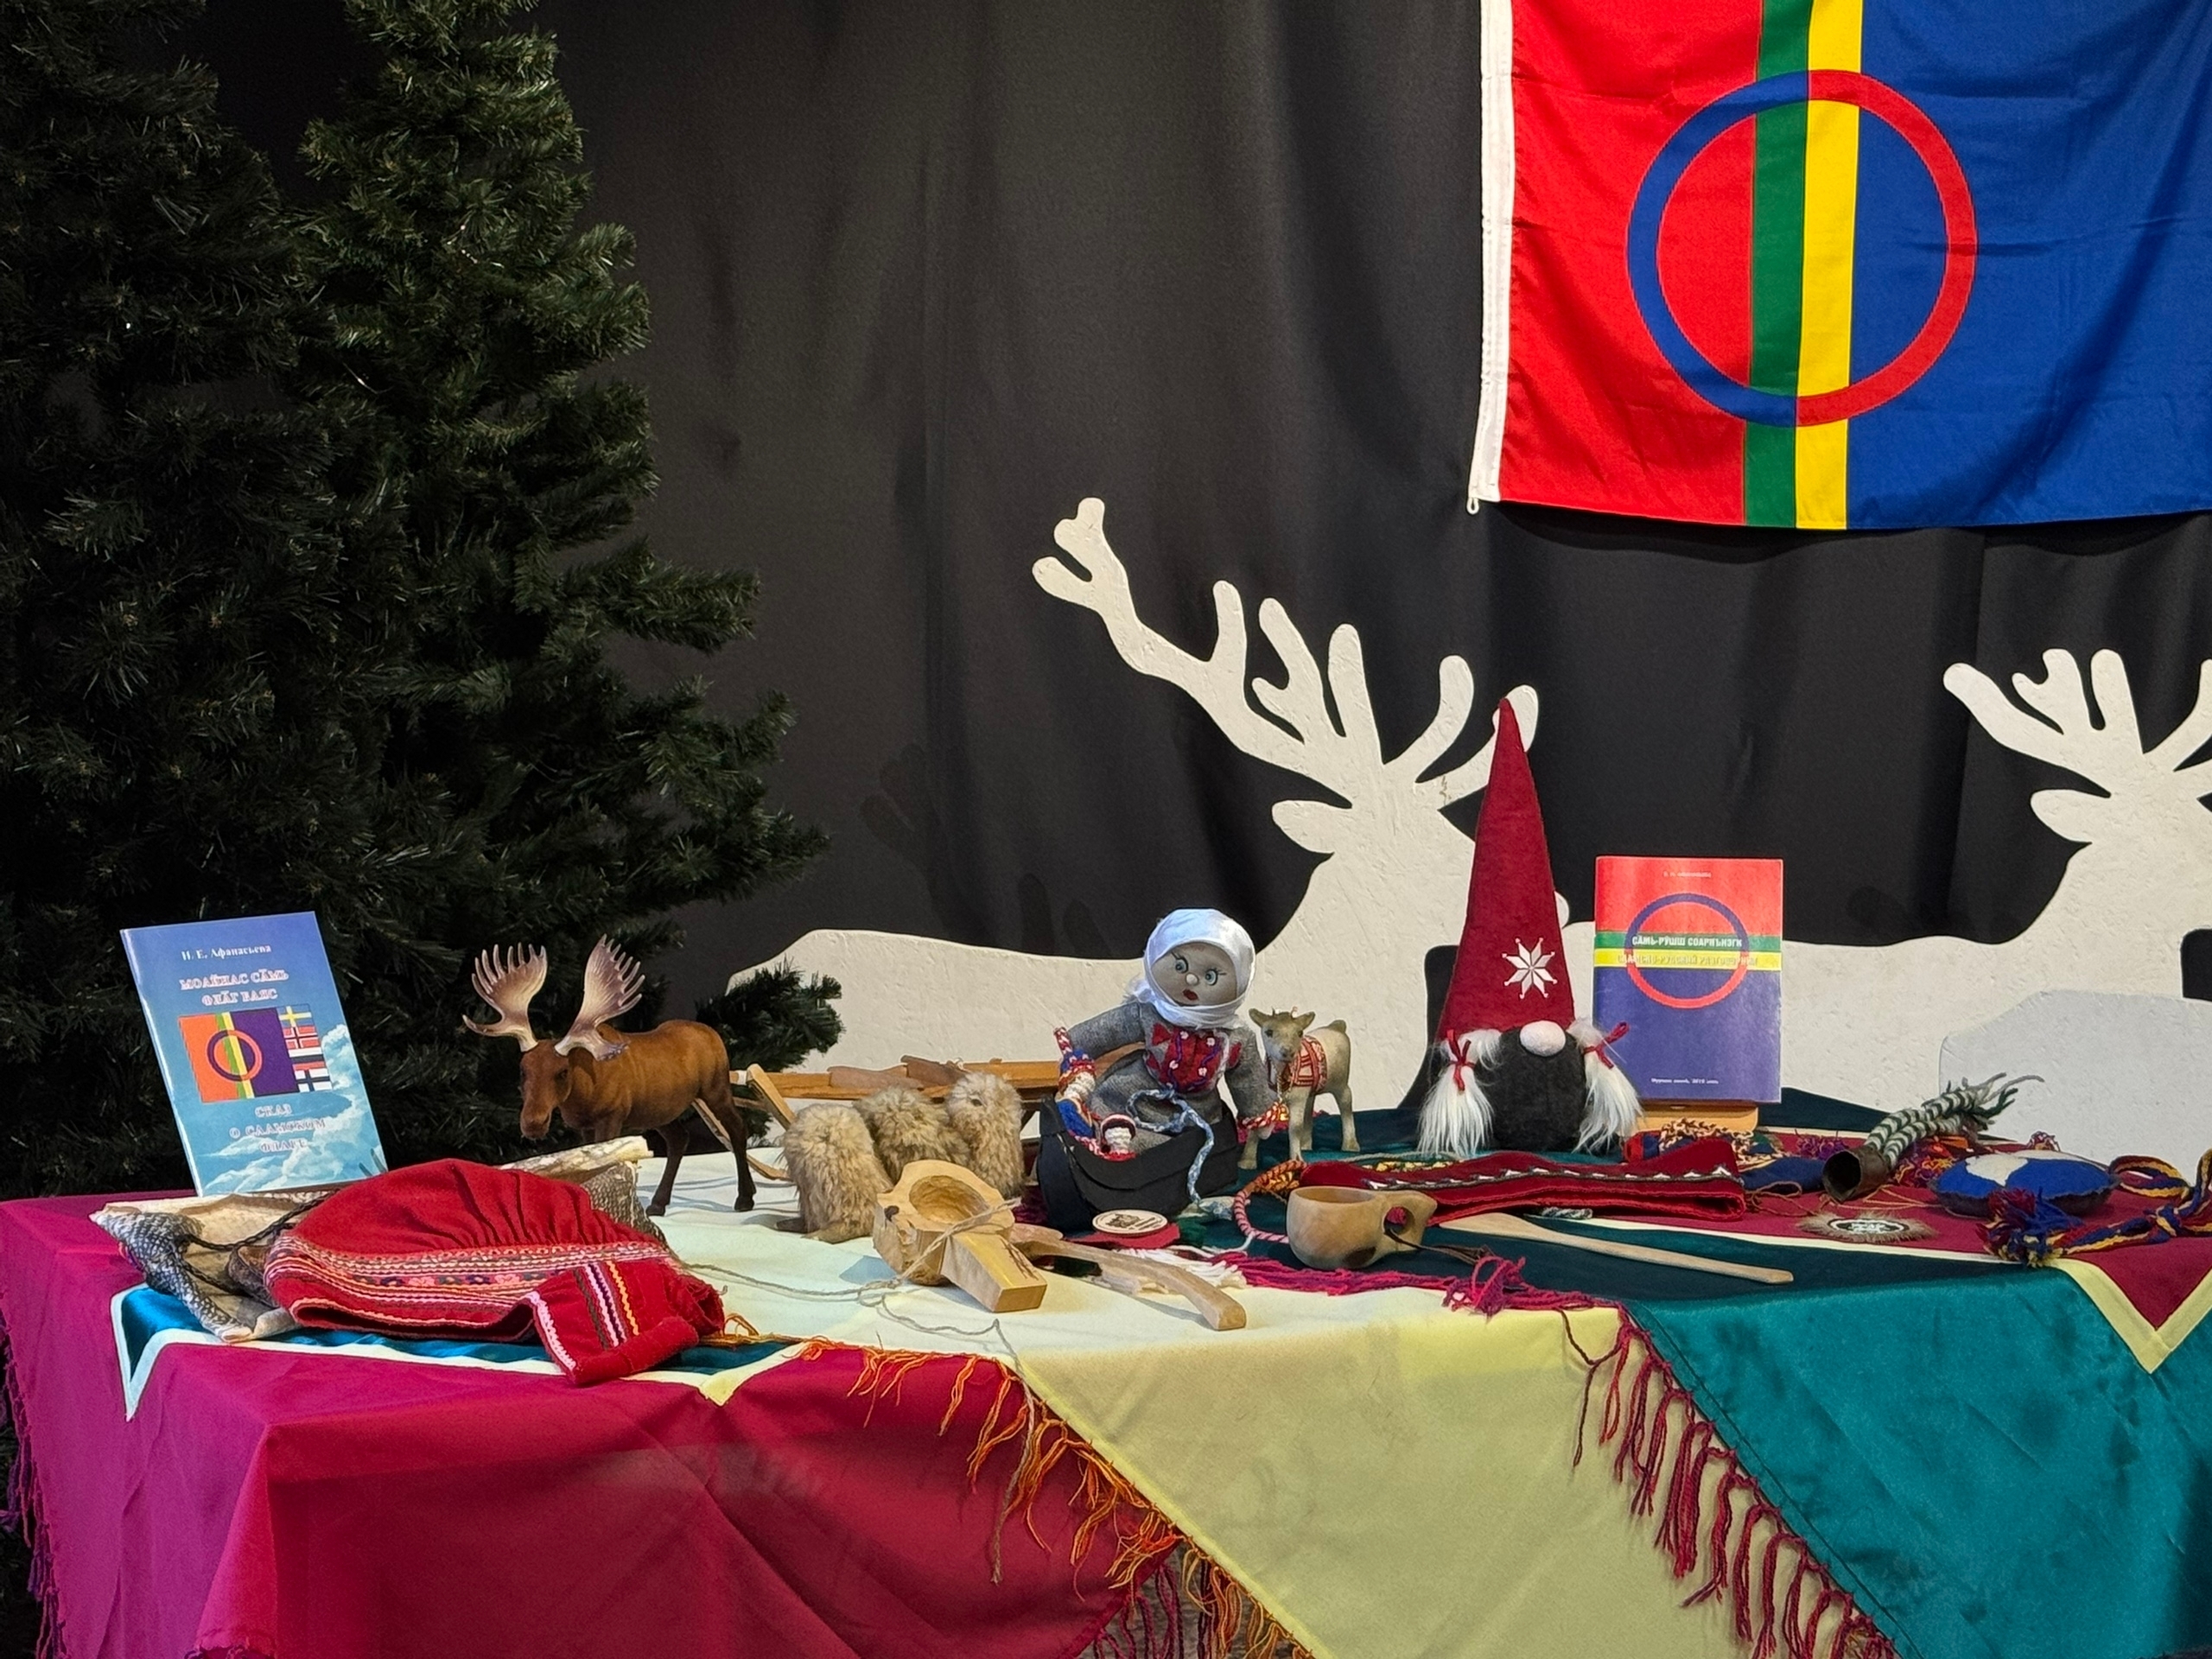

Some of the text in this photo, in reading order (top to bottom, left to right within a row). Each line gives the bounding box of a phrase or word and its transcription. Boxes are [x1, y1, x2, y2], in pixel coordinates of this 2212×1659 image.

[210, 944, 272, 959] Афанасьева
[254, 1103, 292, 1117] СКАЗ
[245, 1118, 326, 1136] СААМСКОМ
[259, 1138, 308, 1153] ФЛАГЕ
